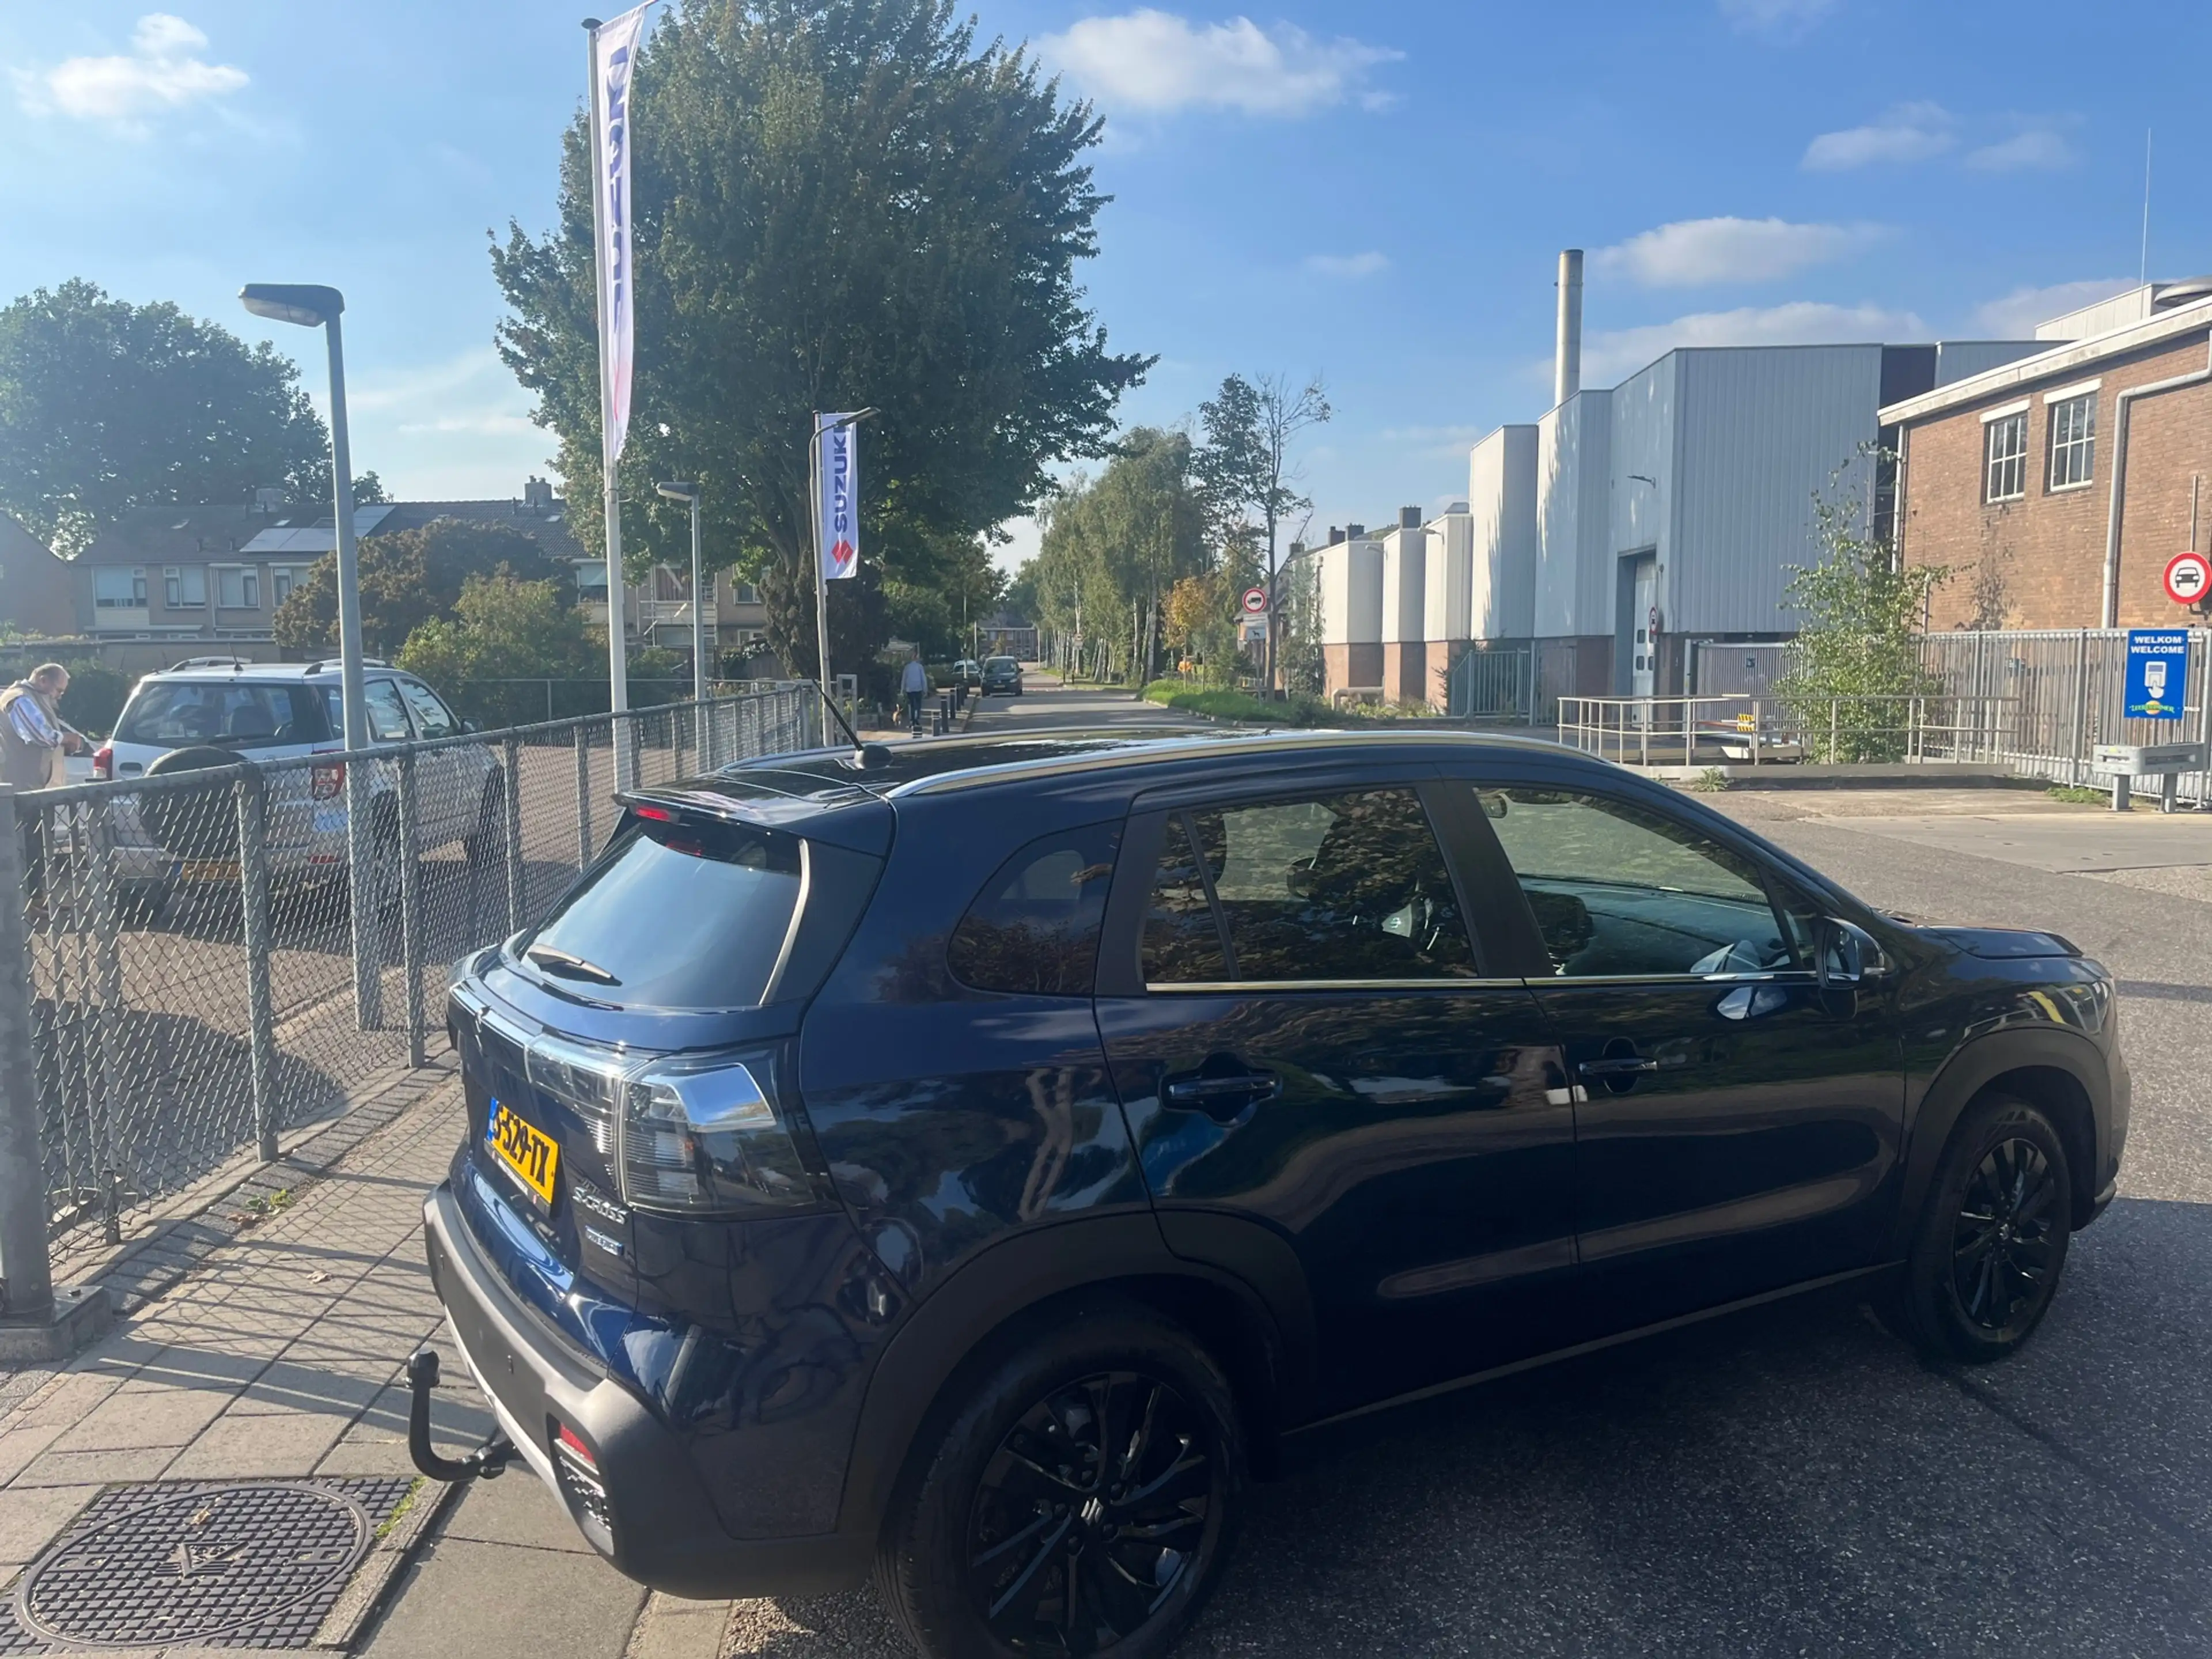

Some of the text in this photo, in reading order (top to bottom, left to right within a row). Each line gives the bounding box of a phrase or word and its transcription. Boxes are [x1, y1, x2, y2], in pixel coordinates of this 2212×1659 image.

[834, 424, 849, 533] SUZUKI
[2134, 635, 2182, 644] WELKOM
[2131, 646, 2185, 654] WELCOME
